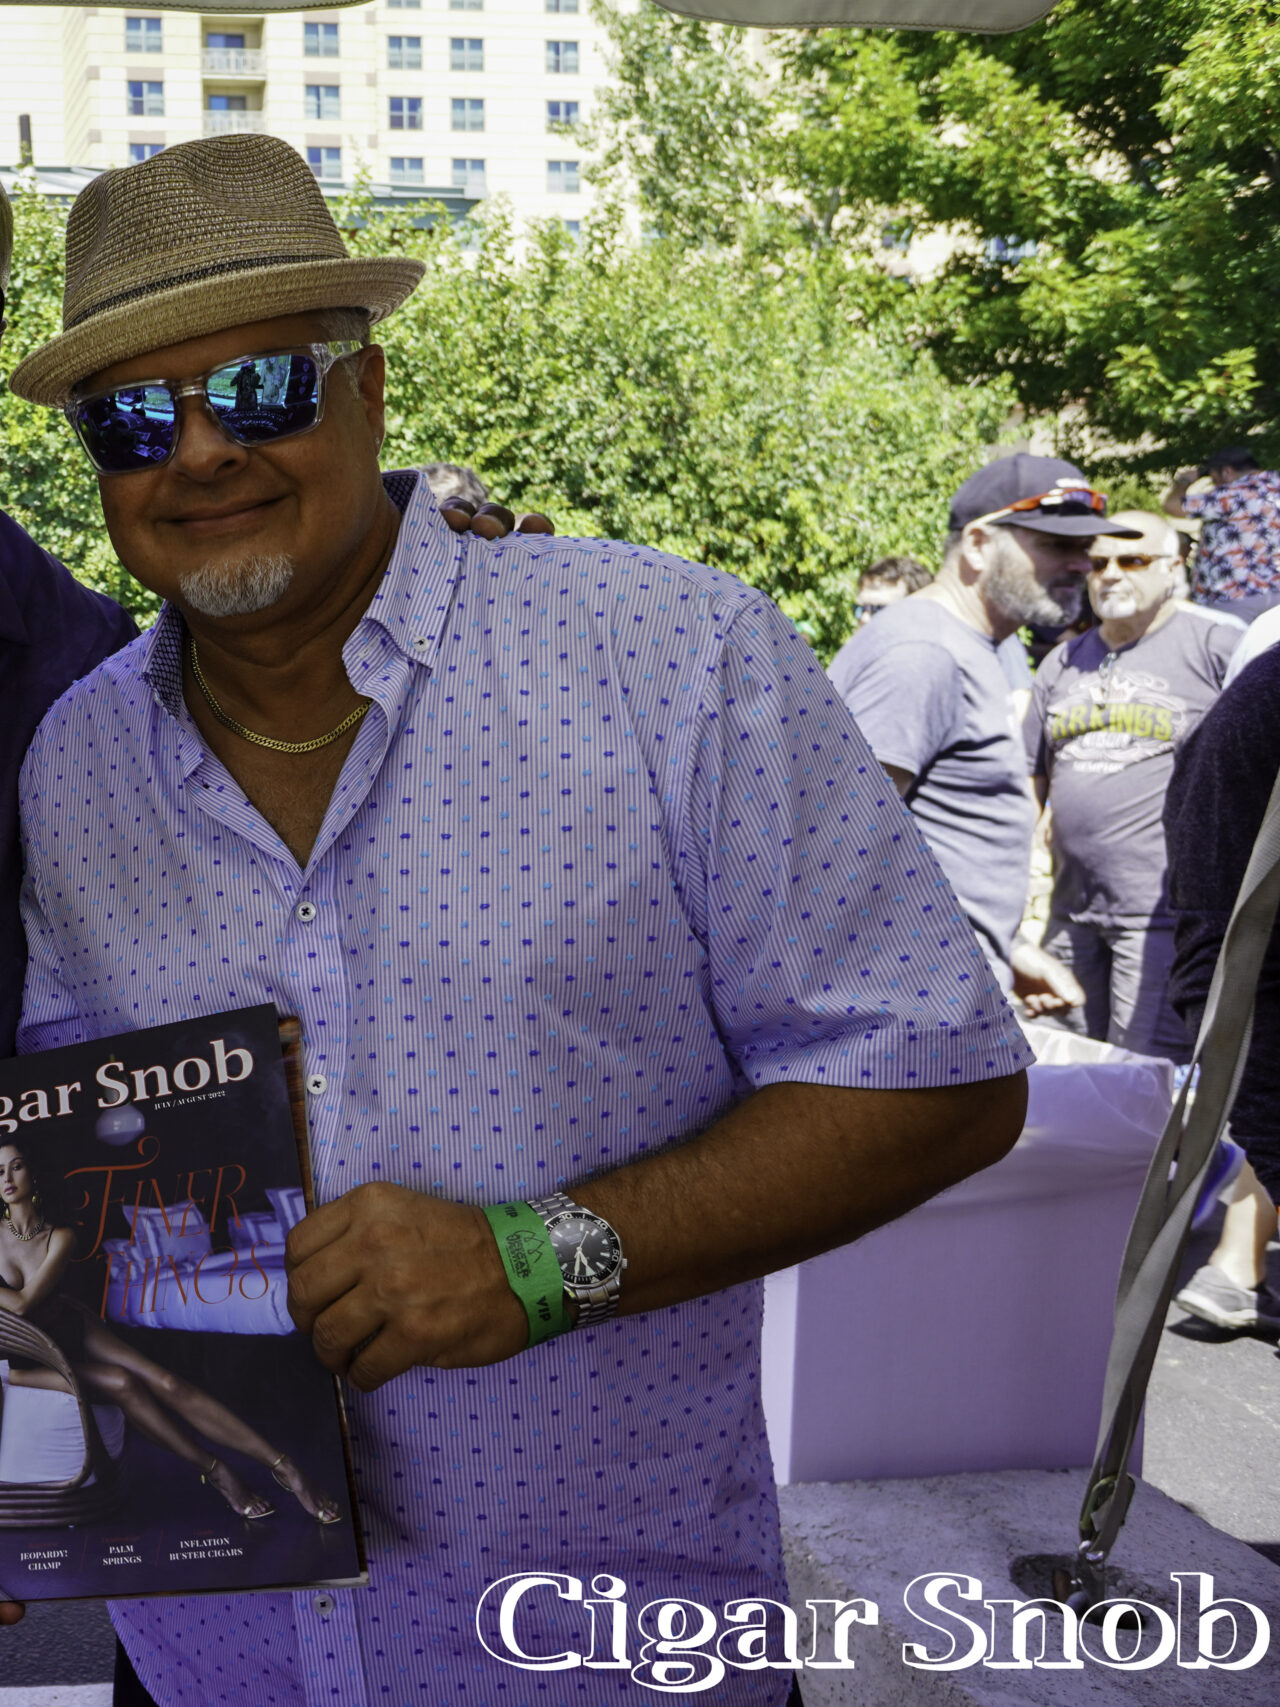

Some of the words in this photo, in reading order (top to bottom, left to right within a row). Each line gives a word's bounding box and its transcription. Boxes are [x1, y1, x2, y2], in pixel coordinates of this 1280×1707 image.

[96, 1039, 254, 1109] Snob
[64, 1136, 246, 1262] FINER
[504, 1205, 519, 1219] VIP
[96, 1240, 270, 1319] THINGS
[536, 1296, 551, 1321] VIP
[109, 1545, 134, 1554] PALM
[180, 1537, 231, 1549] INFLATION
[20, 1549, 68, 1561] JEOPARDY!
[103, 1555, 142, 1566] SPRINGS
[170, 1549, 206, 1561] BUSTER
[207, 1548, 244, 1559] CIGARS
[28, 1562, 61, 1571] CHAMP
